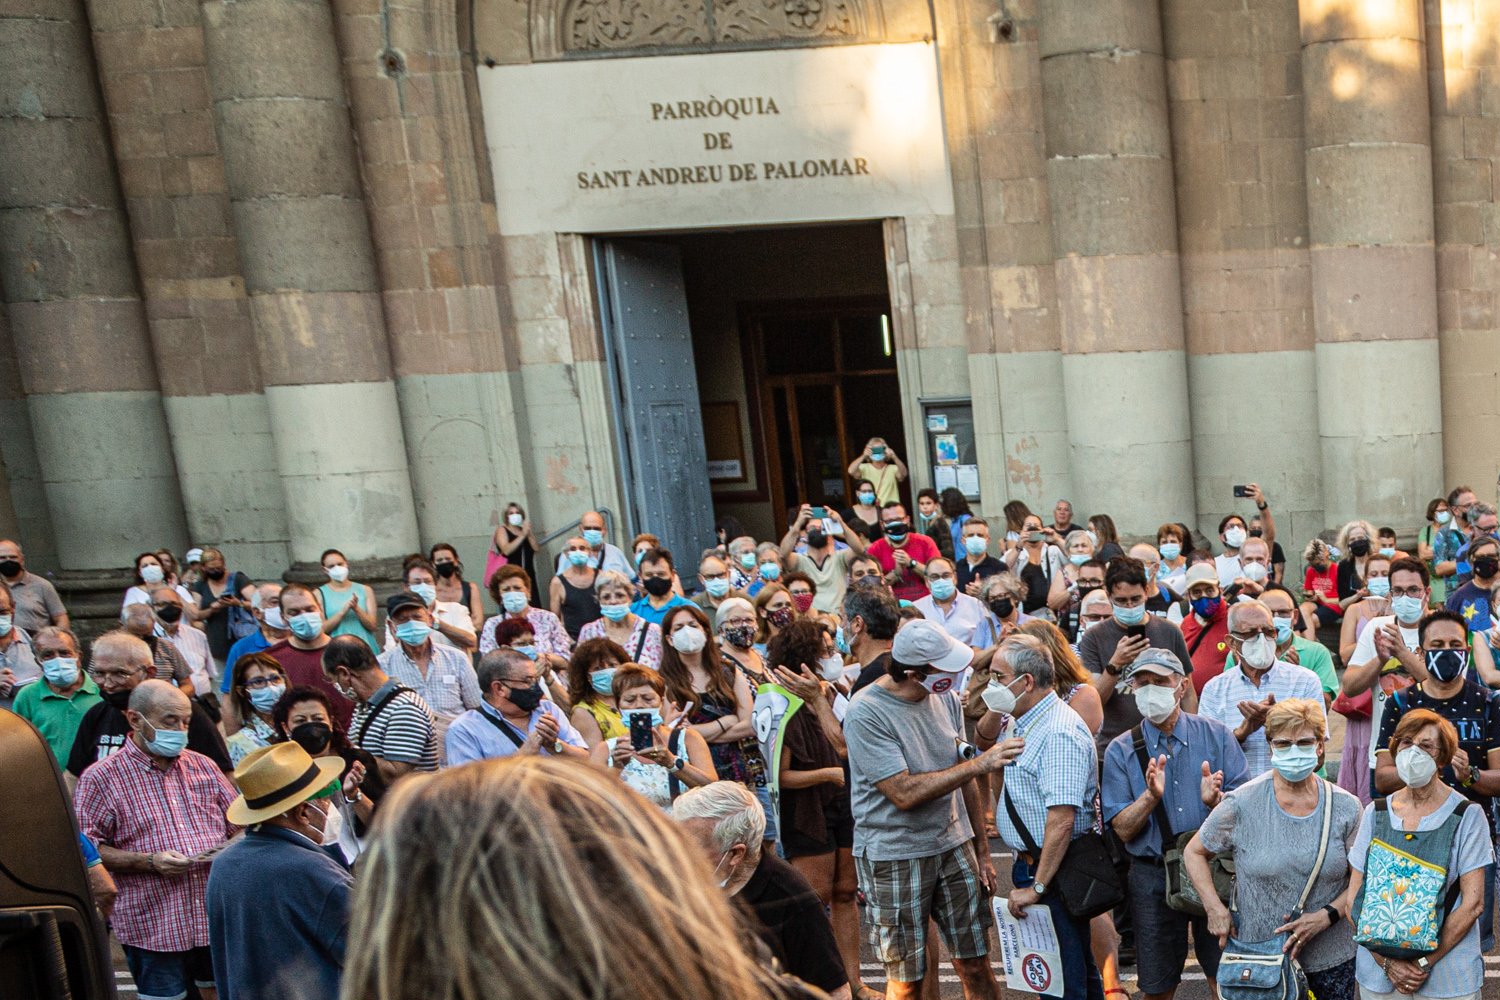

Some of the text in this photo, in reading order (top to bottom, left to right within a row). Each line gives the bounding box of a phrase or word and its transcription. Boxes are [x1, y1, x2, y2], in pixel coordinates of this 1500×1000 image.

[651, 95, 780, 121] PARRÒQUIA
[703, 132, 733, 150] DE
[577, 157, 869, 189] SANT ANDREU DE PALOMAR
[1456, 720, 1481, 739] TA
[996, 907, 1006, 930] NOSTRA
[1003, 940, 1013, 975] RECUPEREM
[1027, 959, 1037, 985] FORA
[1036, 955, 1045, 989] COLAU
